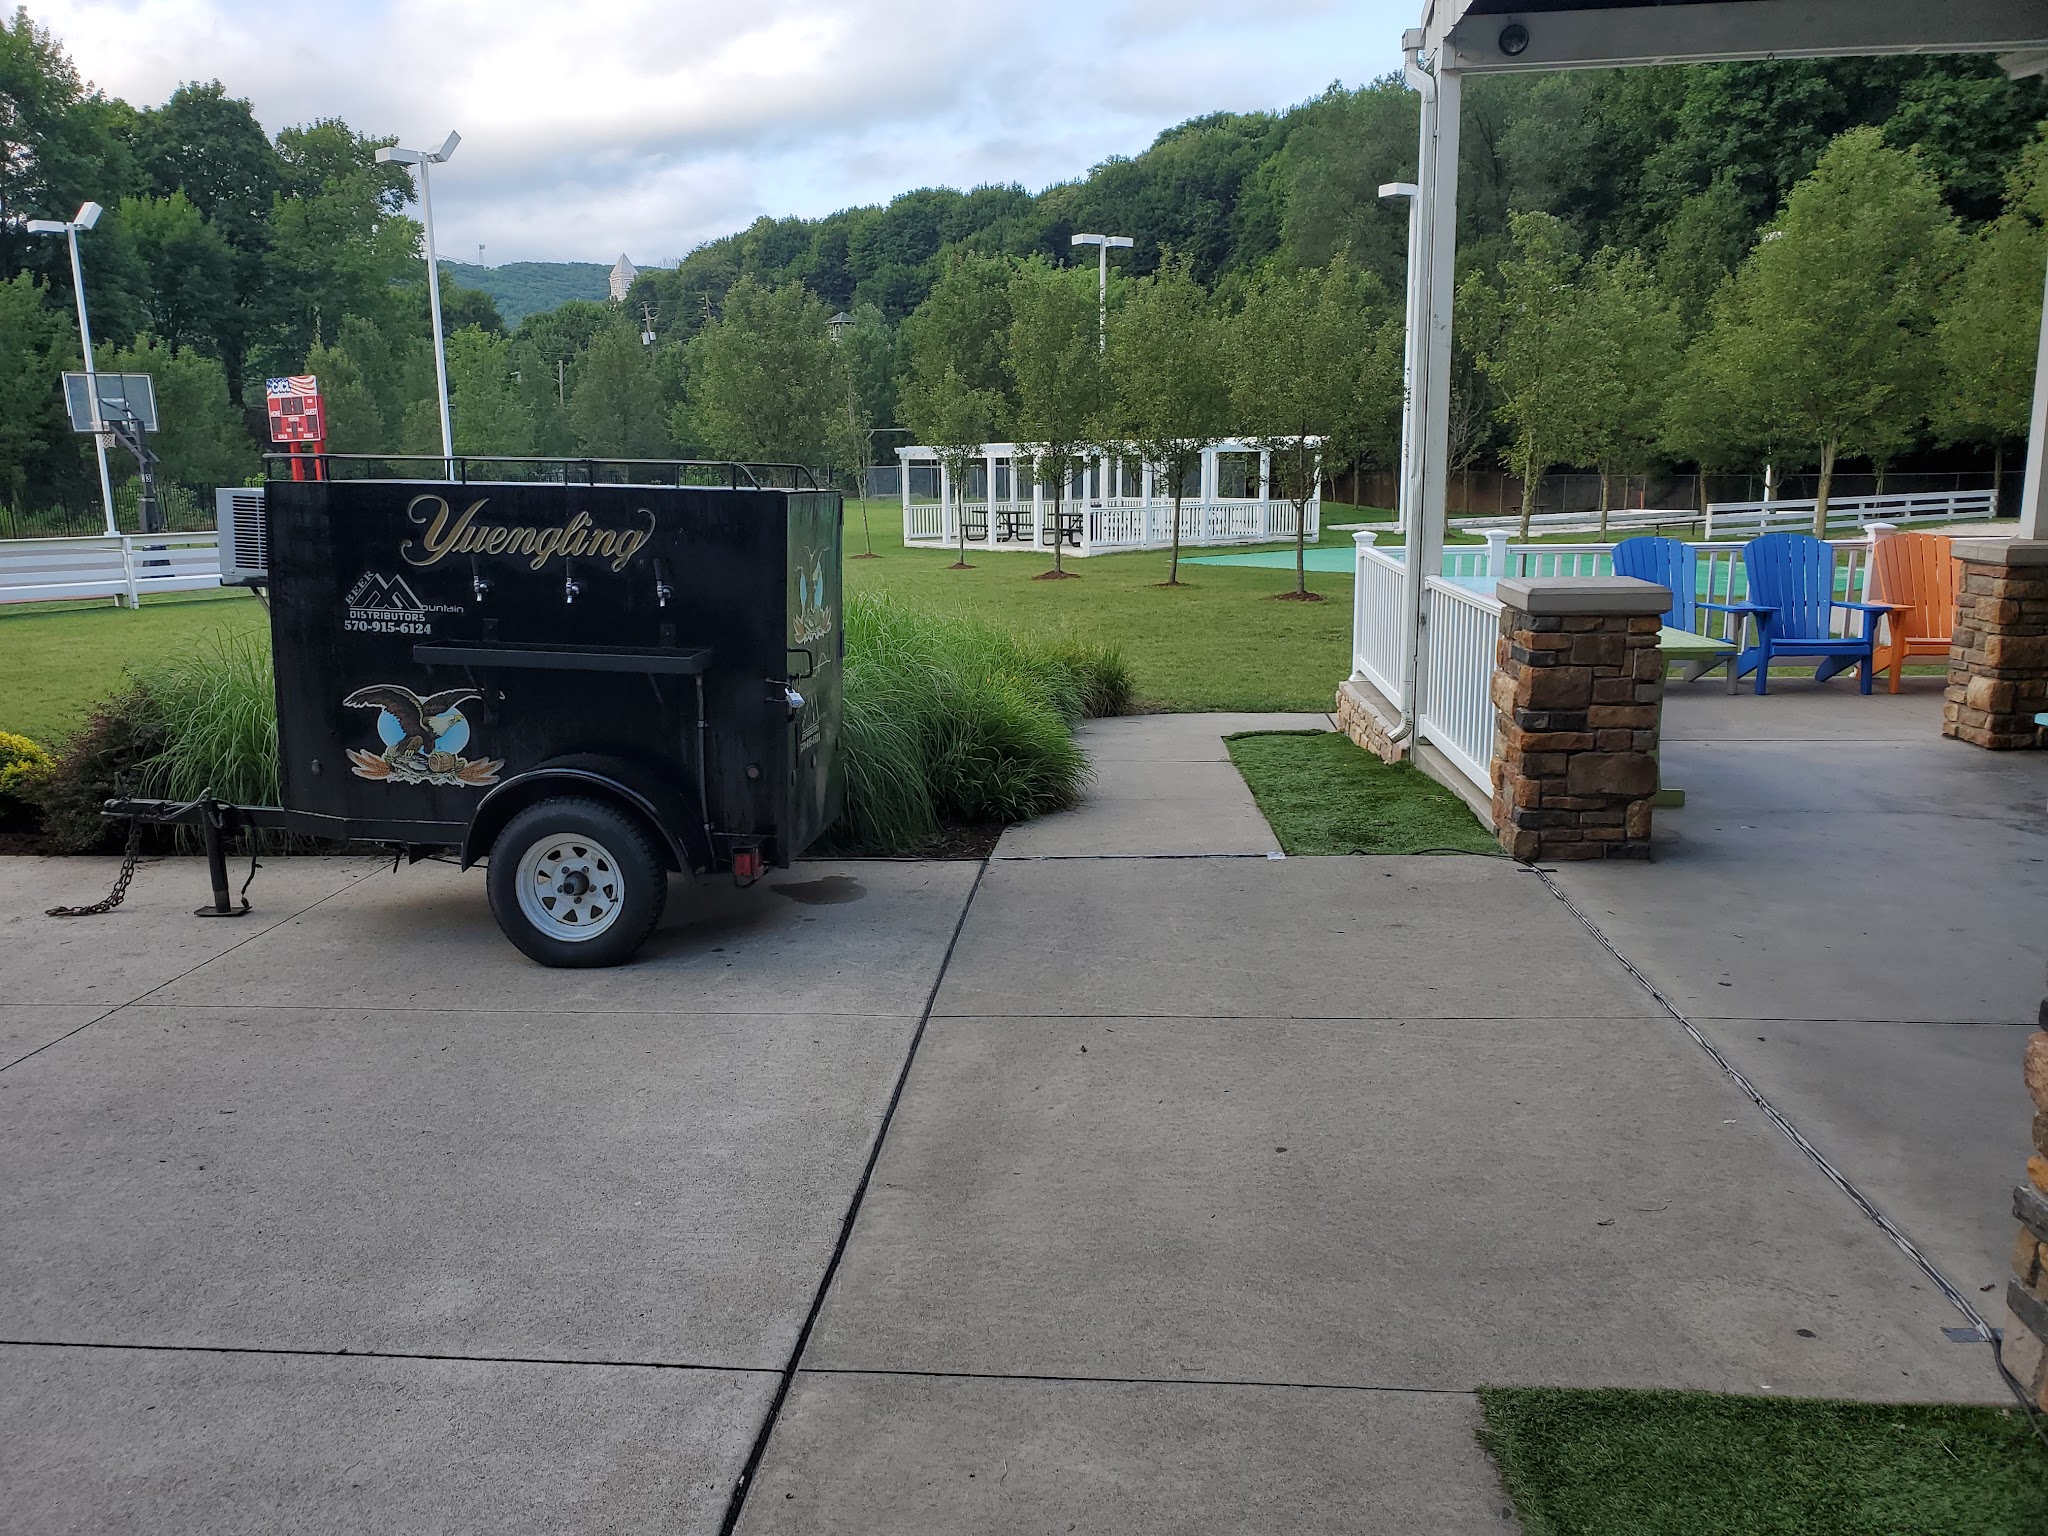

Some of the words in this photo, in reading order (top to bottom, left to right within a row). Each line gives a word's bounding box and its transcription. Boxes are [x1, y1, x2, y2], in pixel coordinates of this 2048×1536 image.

[401, 494, 656, 573] Yuengling
[344, 570, 375, 606] BEER
[344, 619, 432, 635] 570-915-6124
[349, 610, 426, 622] DISTRIBUTORS
